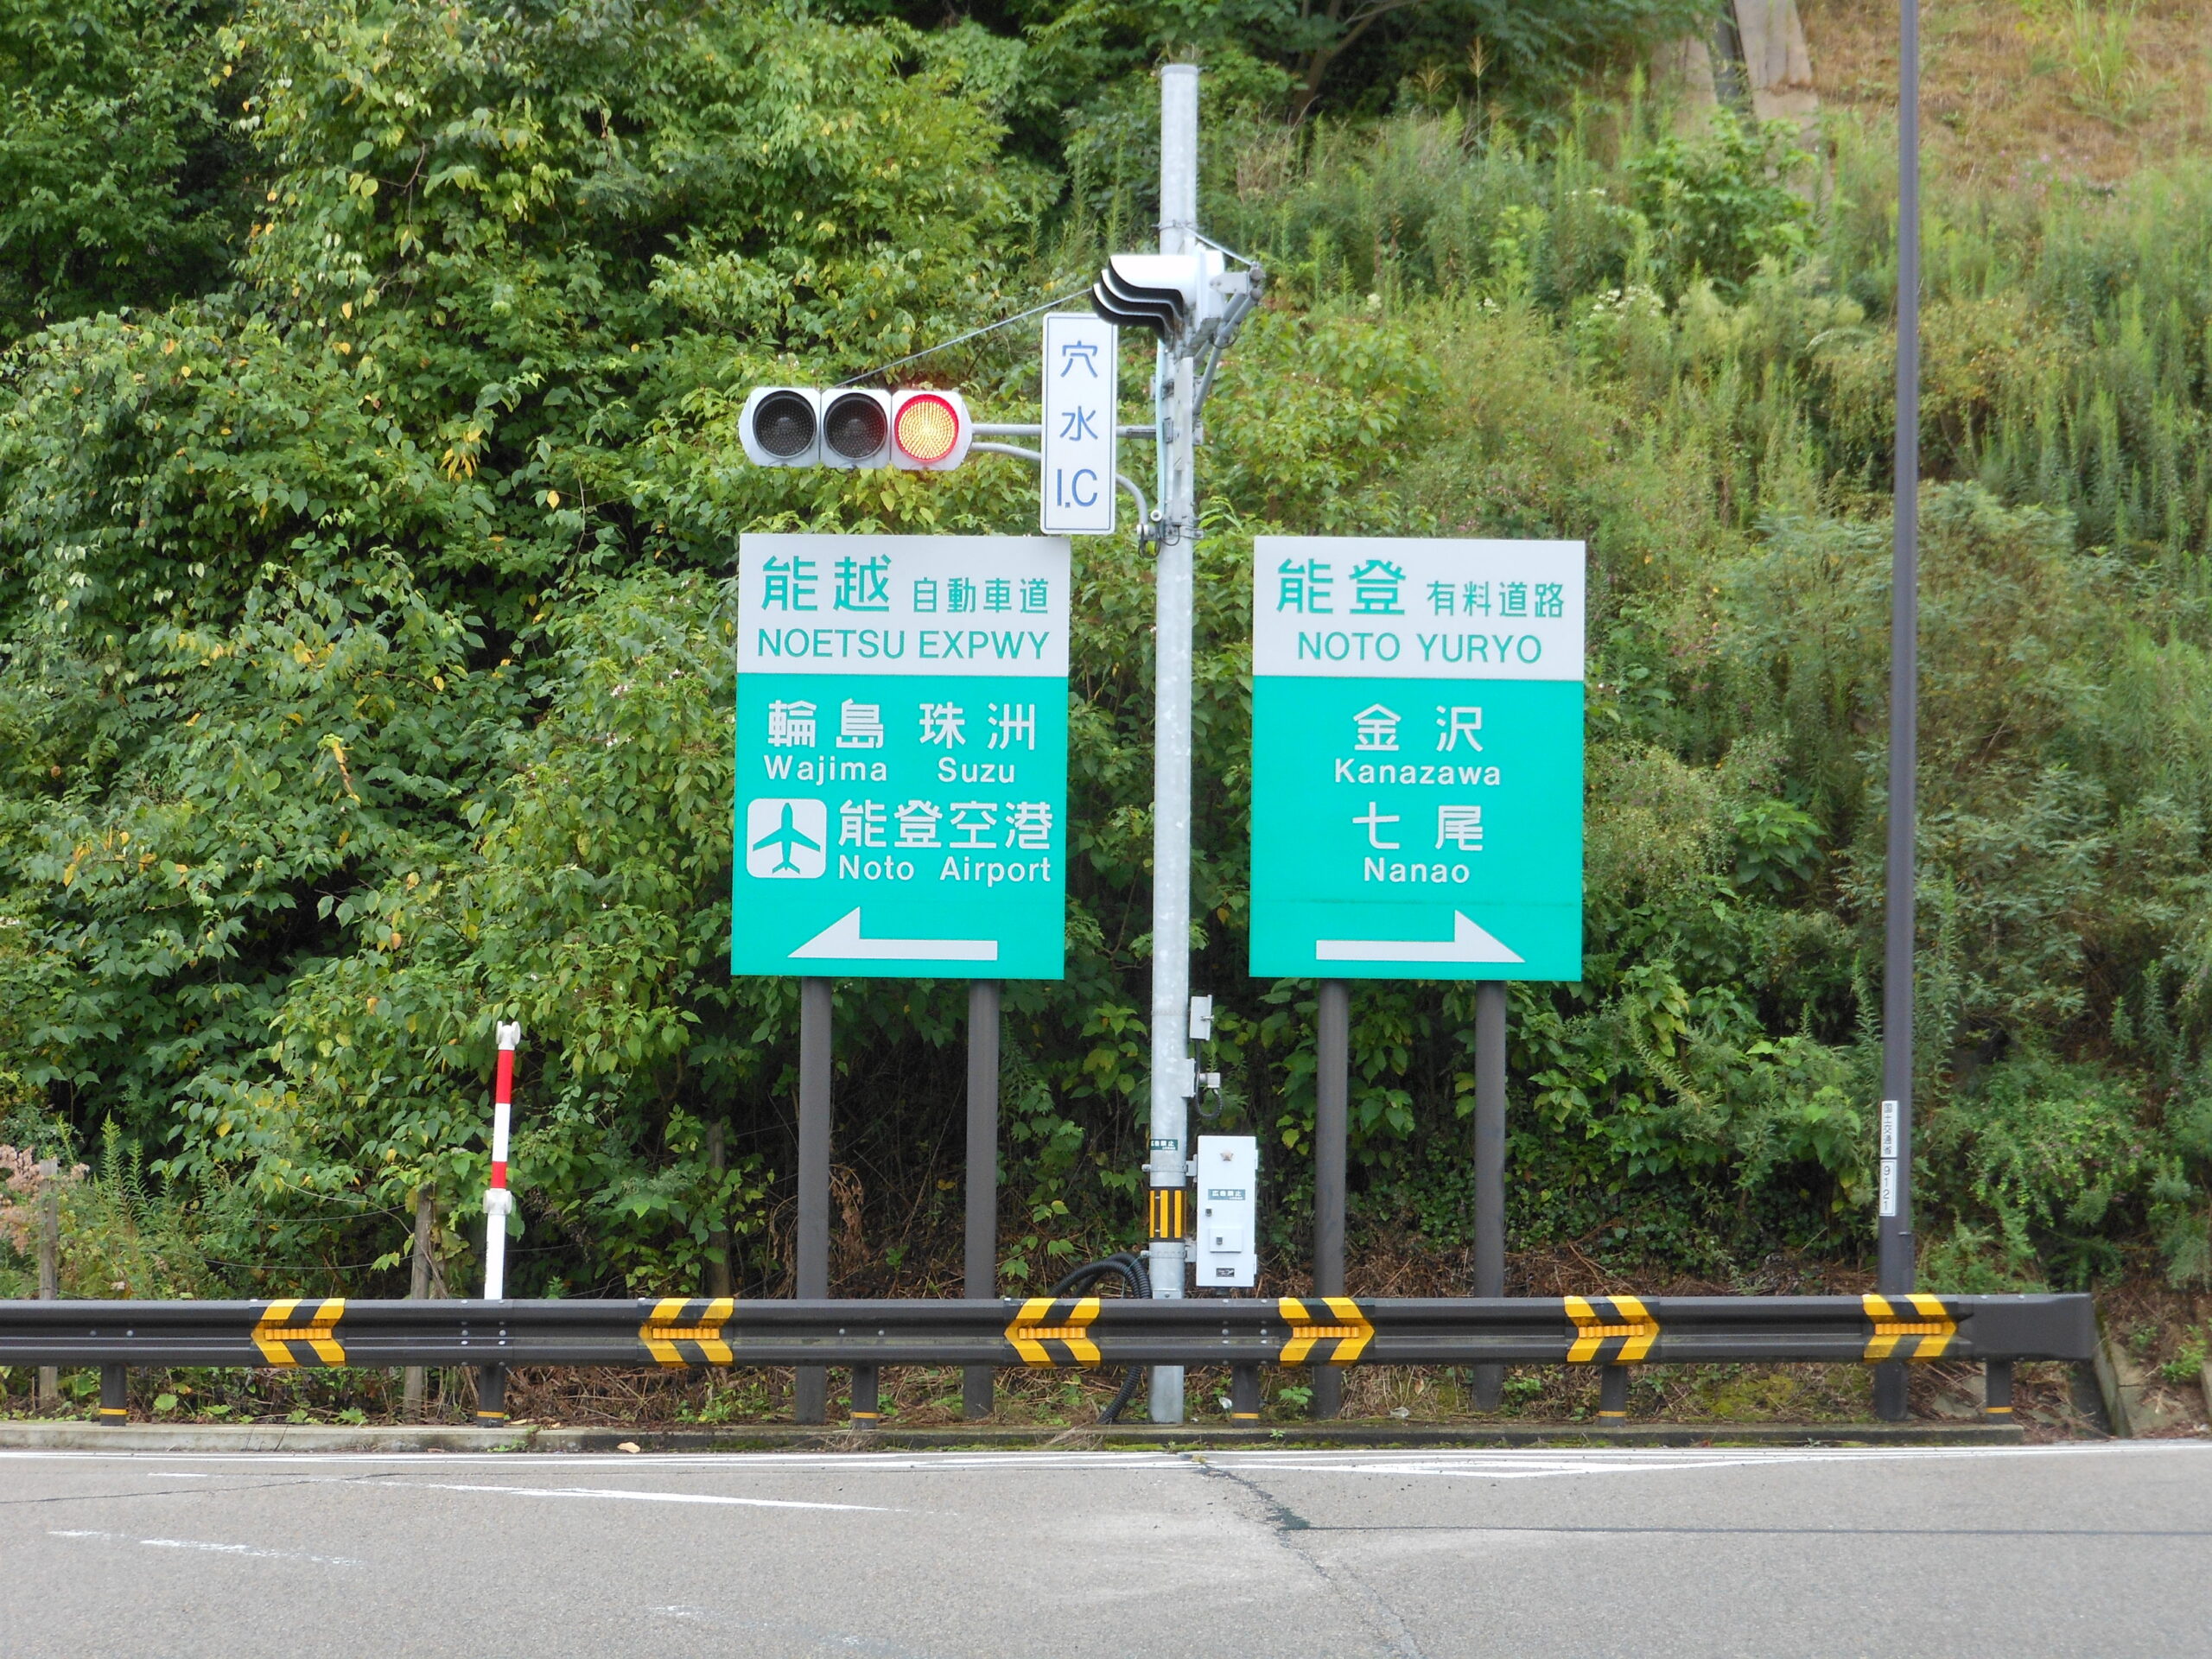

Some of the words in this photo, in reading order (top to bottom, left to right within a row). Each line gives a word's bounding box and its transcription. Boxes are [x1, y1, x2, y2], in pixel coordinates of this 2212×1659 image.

[1059, 340, 1098, 442] 穴水
[761, 553, 893, 613] 能越
[912, 576, 1050, 614] 自動車道
[1275, 557, 1407, 616] 能登
[1426, 580, 1566, 620] 有料道路
[757, 627, 906, 659] NOETSU
[918, 630, 1051, 660] EXPWY
[1297, 631, 1401, 662] NOTO
[1416, 633, 1543, 664] YURYO
[767, 698, 885, 749] 輪島
[918, 701, 1036, 751] 珠洲
[1352, 702, 1484, 753] 金沢
[763, 754, 888, 785] Wajima
[937, 756, 1016, 784] Suzu
[1334, 758, 1501, 786] Kanazawa
[838, 798, 1054, 850] 能登空港
[1351, 801, 1484, 852] 七尾
[838, 855, 915, 881] Noto
[938, 855, 1052, 887] Airport
[1363, 856, 1471, 885] Nanao
